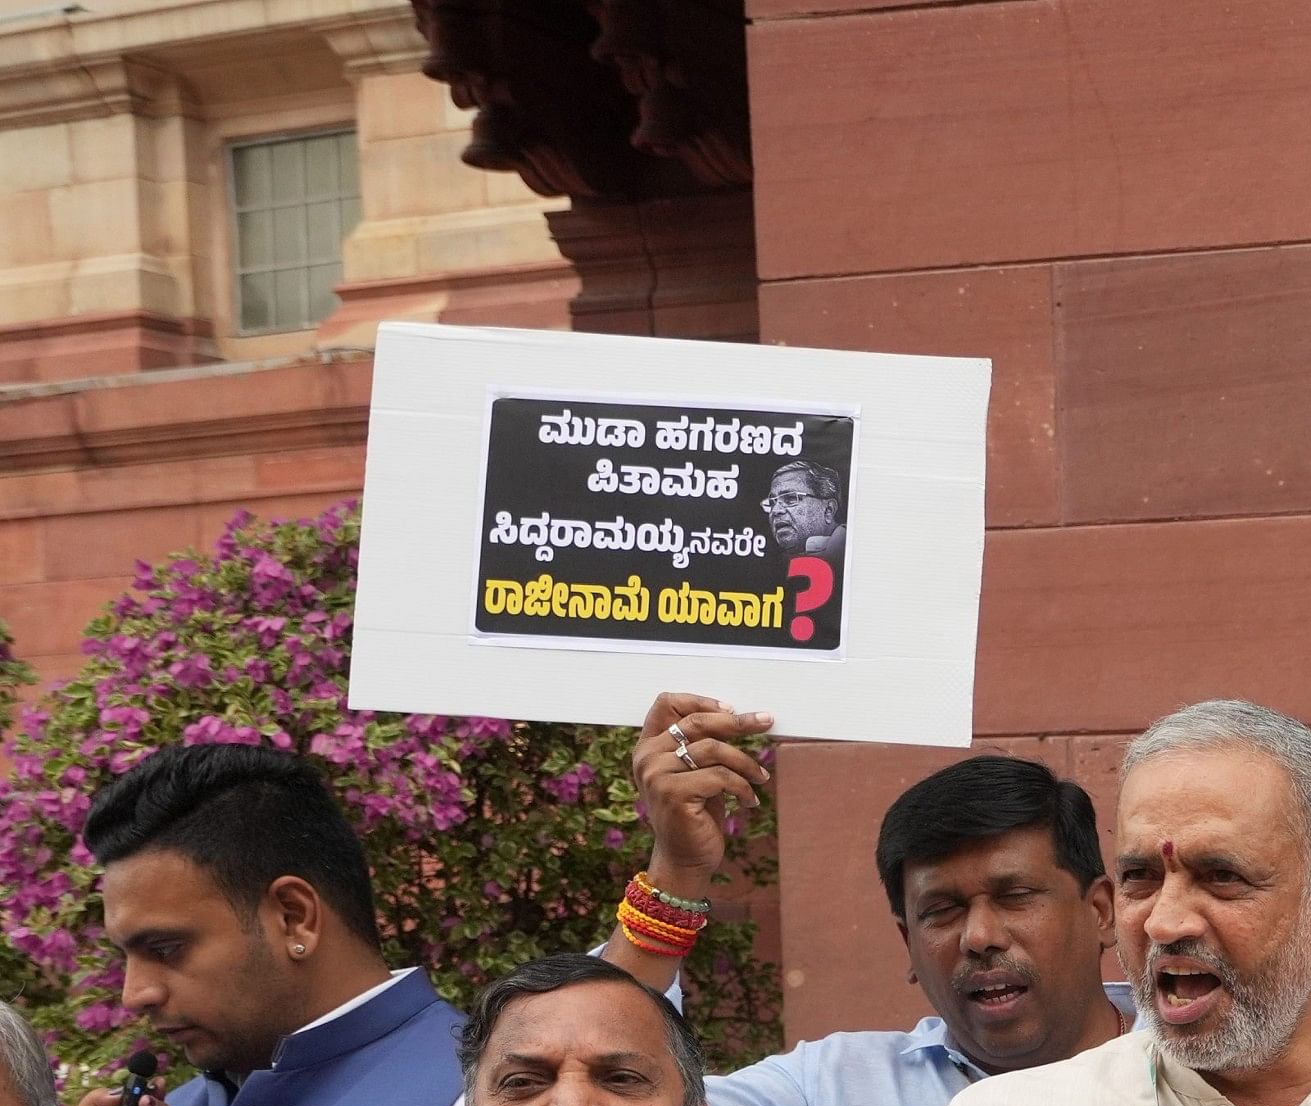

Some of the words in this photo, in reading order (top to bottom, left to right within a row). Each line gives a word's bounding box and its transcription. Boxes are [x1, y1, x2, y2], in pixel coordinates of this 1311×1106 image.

[538, 408, 646, 448] ಮುಡಾ
[655, 415, 804, 456] ಹಗರಣದ
[587, 458, 739, 500] ಪಿತಾಮಹ
[483, 574, 649, 623] ರಾಜೀನಾಮೆ
